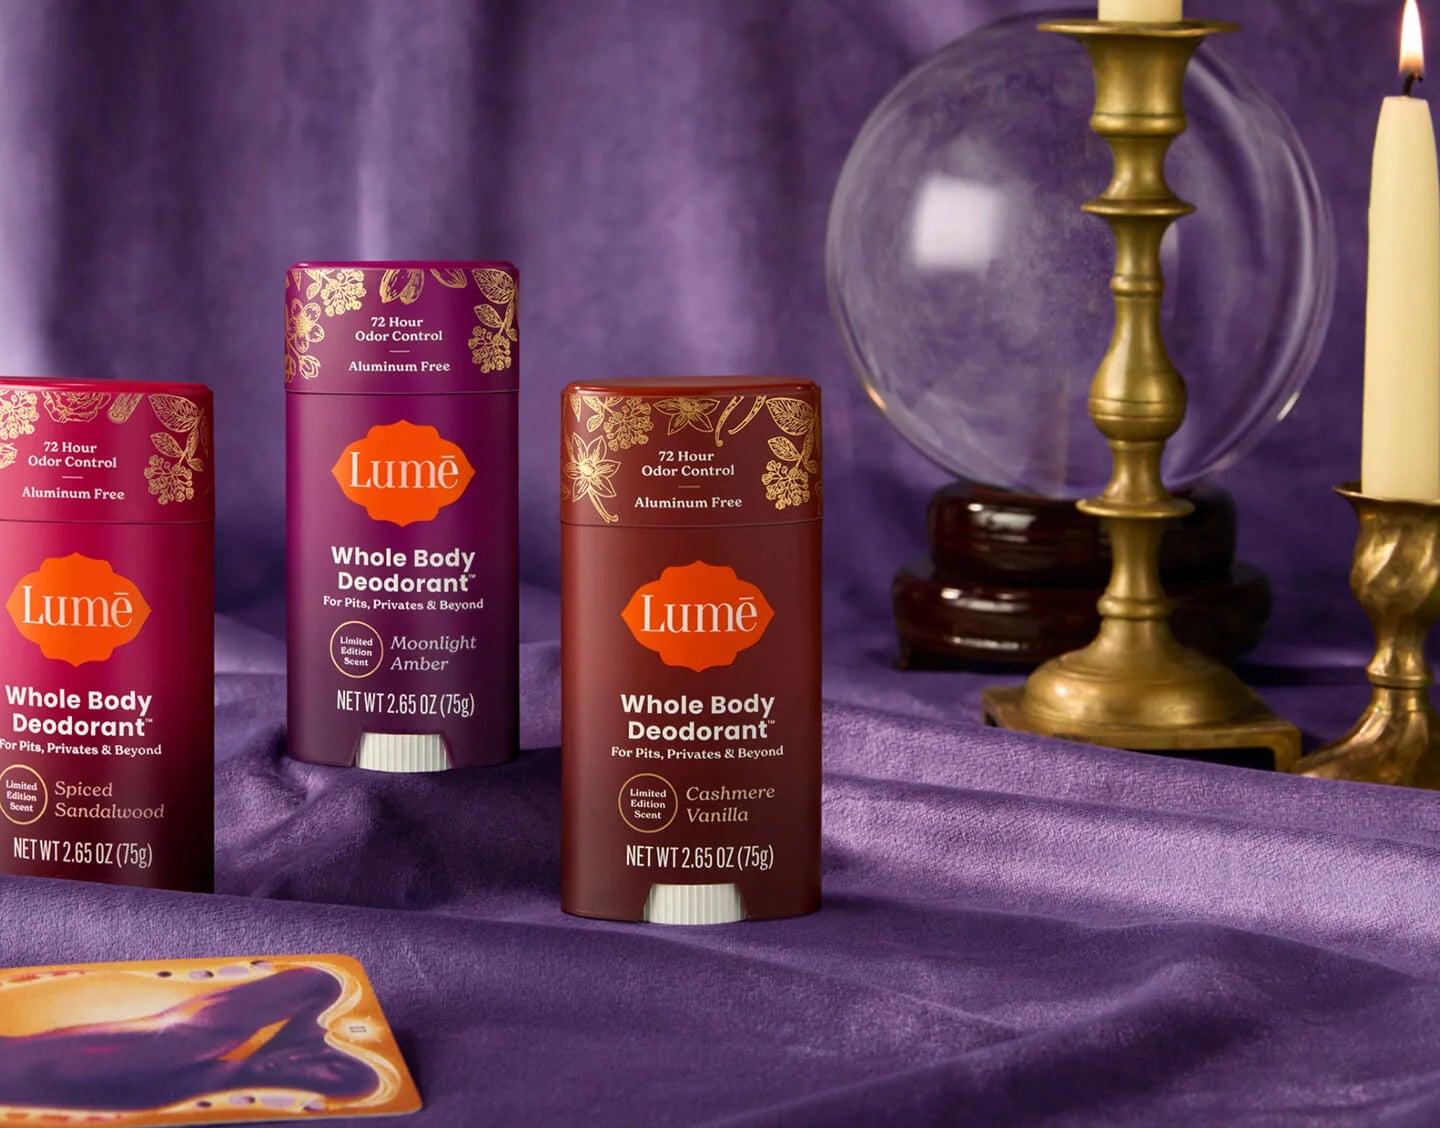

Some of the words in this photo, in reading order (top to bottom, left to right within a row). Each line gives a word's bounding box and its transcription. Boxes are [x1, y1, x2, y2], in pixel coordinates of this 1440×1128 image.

[371, 317, 385, 327] 72
[389, 317, 423, 327] Hour
[355, 331, 389, 341] Odor
[392, 331, 442, 341] Control
[348, 361, 417, 371] Aluminum
[421, 361, 449, 371] Free
[44, 442, 58, 452] 72
[62, 442, 97, 453] Hour
[28, 455, 62, 466] Odor
[65, 456, 116, 468] Control
[659, 451, 674, 461] 72
[678, 451, 714, 461] Hour
[350, 452, 458, 488] Lumē
[642, 465, 678, 476] Odor
[681, 465, 734, 476] Control
[21, 486, 90, 498] Aluminum
[95, 489, 124, 499] Free
[635, 497, 707, 508] Aluminum
[712, 497, 742, 507] Free
[331, 546, 406, 567] Whole
[414, 548, 475, 573] Body
[22, 585, 132, 627] Lumē
[324, 596, 342, 606] For
[345, 598, 370, 609] Pits,
[373, 599, 424, 610] Privates
[427, 600, 436, 610] &
[440, 599, 483, 612] Beyond
[642, 595, 757, 633] Lumē
[340, 636, 372, 646] Limited
[391, 636, 476, 653] Moonlight
[341, 647, 372, 657] Edition
[344, 657, 368, 666] Scent
[391, 657, 448, 670] Amber
[5, 685, 80, 709] Whole
[89, 691, 152, 716] Body
[337, 690, 361, 711] NET
[364, 692, 384, 712] WT
[387, 693, 416, 714] 2.65
[420, 694, 436, 714] OZ
[440, 693, 474, 717] (75g)
[621, 694, 703, 714] Whole
[712, 694, 775, 720] Body
[0, 738, 17, 750] For
[20, 741, 44, 754] Pits,
[47, 743, 98, 755] Privates
[101, 745, 111, 755] &
[115, 745, 161, 757] Beyond
[612, 747, 632, 757] For
[636, 748, 664, 760] Pits,
[668, 749, 721, 759] Privates
[725, 749, 734, 758] &
[738, 745, 783, 759] Beyond
[6, 780, 37, 791] Limited
[55, 781, 112, 798] Spiced
[7, 791, 37, 802] Edition
[630, 789, 666, 798] Limited
[686, 786, 774, 800] Cashmere
[10, 803, 34, 813] Scent
[55, 802, 164, 818] Sandalwood
[631, 799, 665, 809] Edition
[634, 810, 661, 819] Scent
[687, 807, 748, 822] Vanilla
[14, 837, 37, 859] NET
[40, 840, 60, 861] WT
[63, 841, 92, 863] 2.65
[96, 843, 113, 864] OZ
[117, 843, 152, 868] (75g)
[627, 845, 653, 866] NET
[657, 847, 678, 867] WT
[682, 847, 712, 868] 2.65
[717, 847, 734, 868] OZ
[738, 845, 773, 870] (75g)
